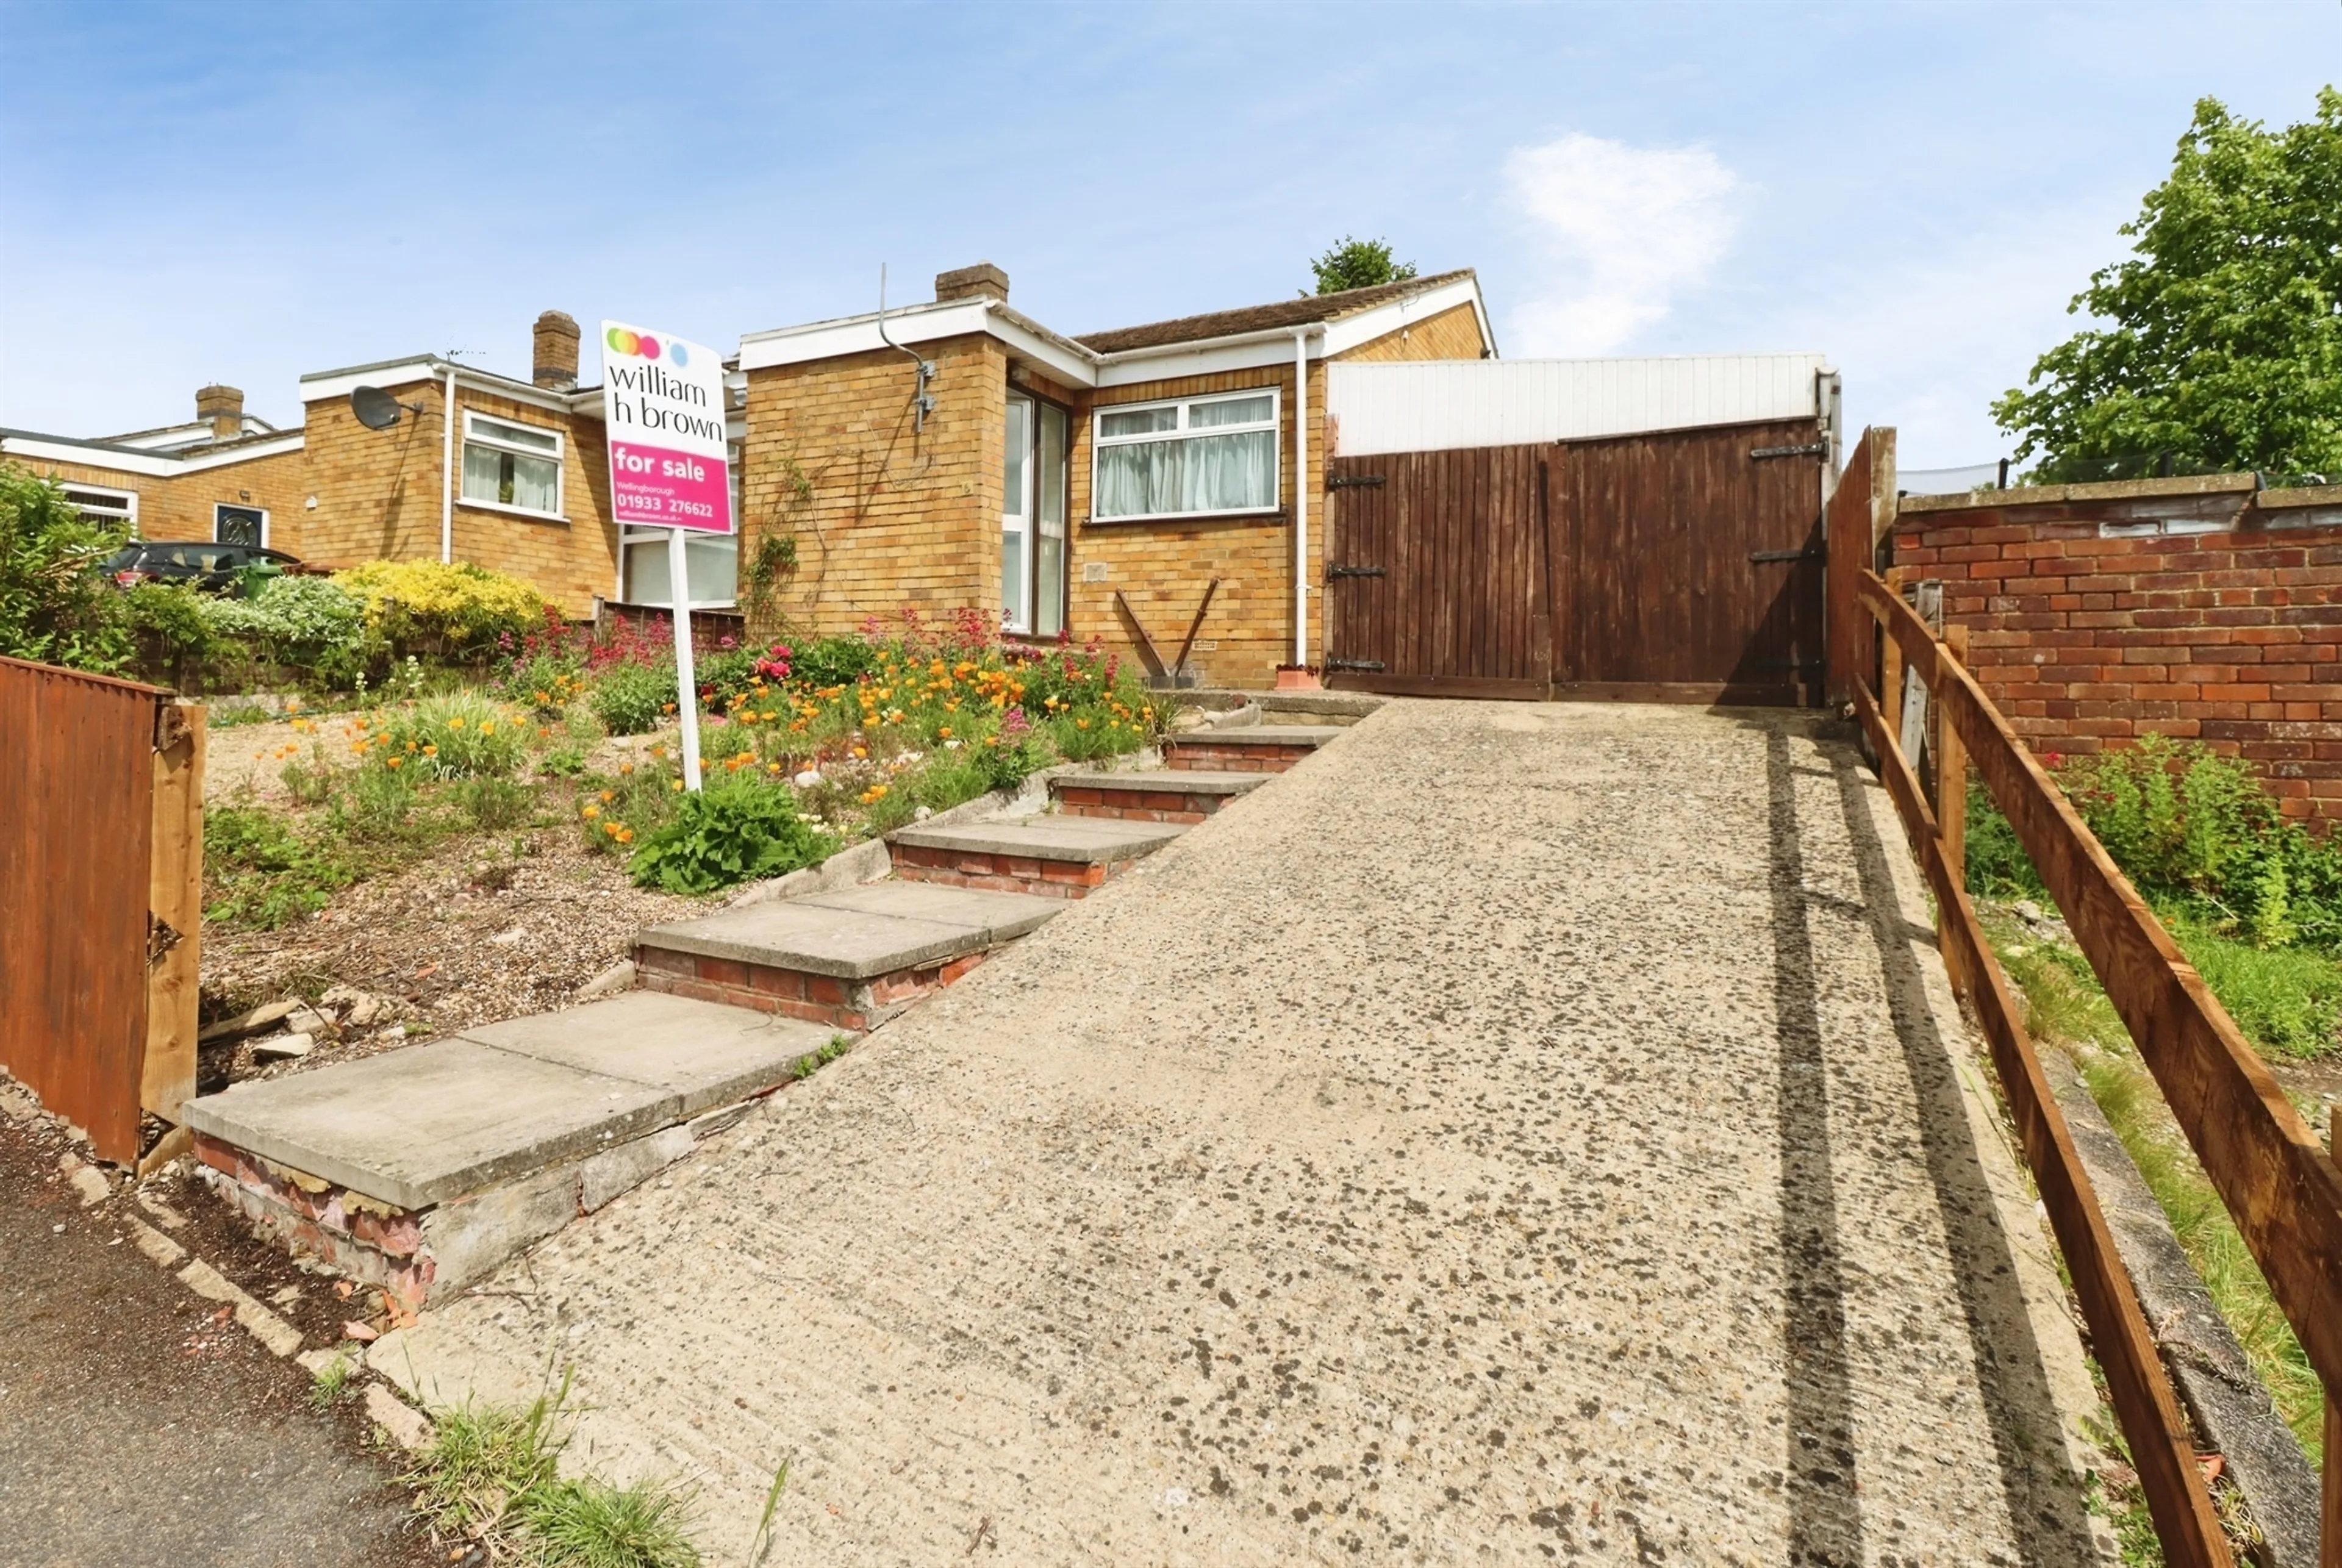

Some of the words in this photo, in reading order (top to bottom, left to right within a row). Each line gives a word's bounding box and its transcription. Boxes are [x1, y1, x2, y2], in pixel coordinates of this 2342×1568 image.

[609, 365, 706, 407] william
[615, 392, 632, 423] h
[641, 396, 722, 442] brown
[615, 447, 654, 473] for
[662, 457, 705, 482] sale
[617, 482, 675, 496] Wellingborough
[617, 493, 661, 510] 01933
[668, 499, 712, 517] 276622
